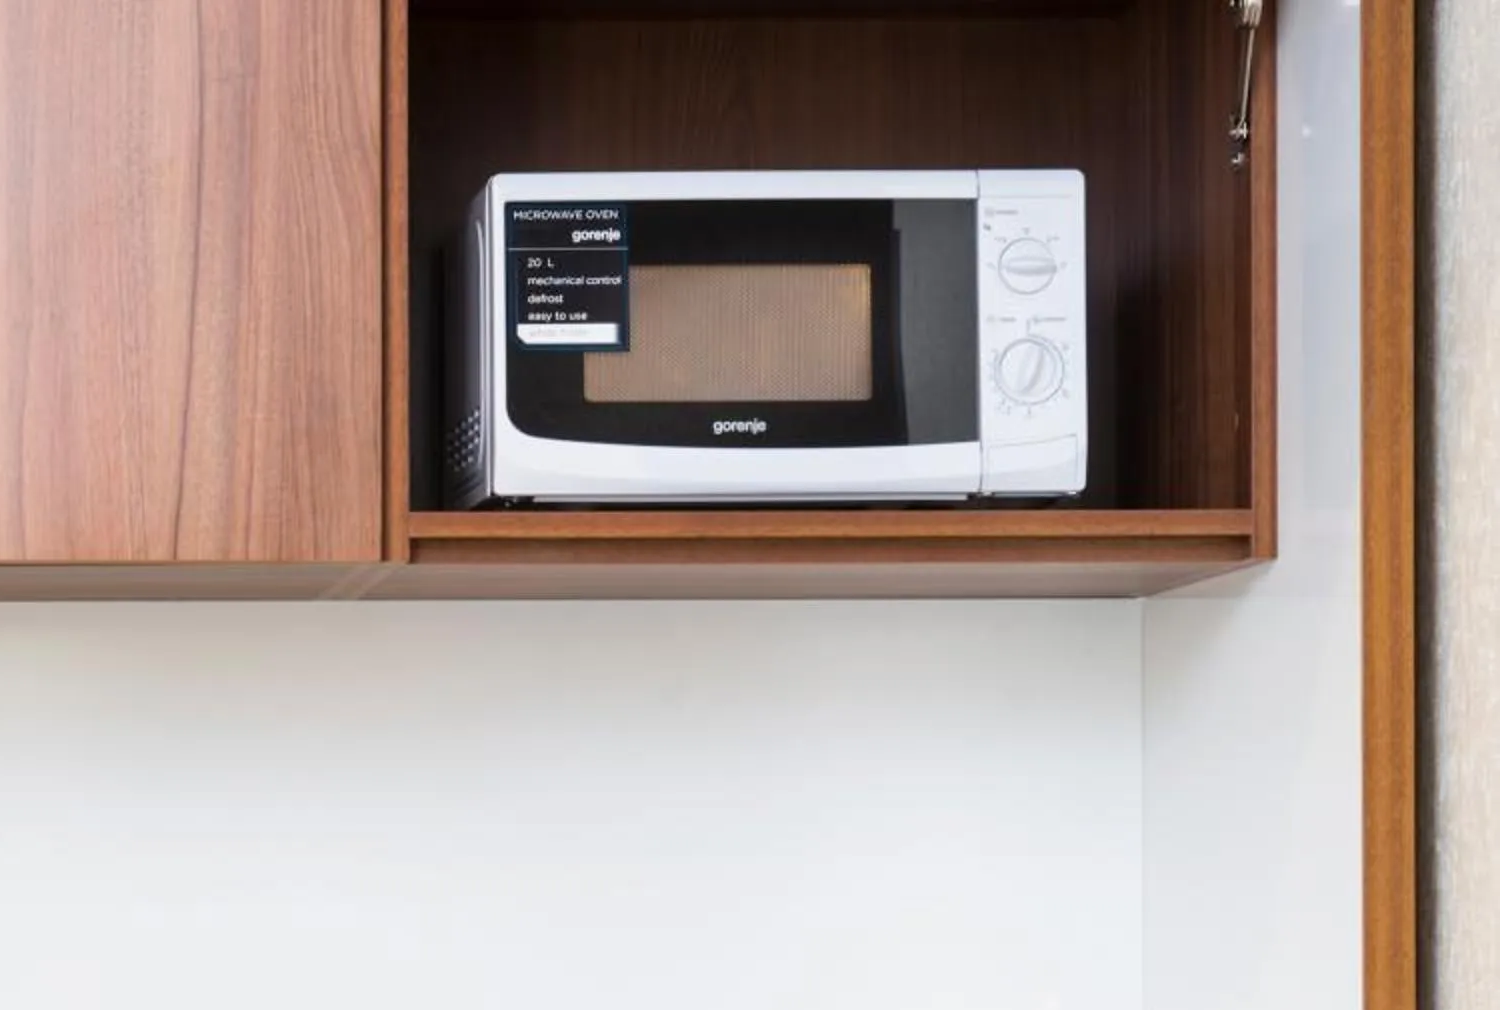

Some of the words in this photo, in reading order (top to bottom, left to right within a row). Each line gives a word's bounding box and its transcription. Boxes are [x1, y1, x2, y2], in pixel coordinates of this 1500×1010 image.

[513, 209, 583, 221] MICROWAVE
[585, 209, 619, 220] OVEN
[571, 228, 621, 243] gorenje
[527, 258, 542, 268] 20
[527, 275, 584, 286] mechanical
[586, 275, 621, 285] control
[527, 294, 564, 304] defrost
[527, 312, 552, 323] easy
[555, 311, 567, 321] to
[569, 313, 588, 321] use
[713, 417, 767, 435] gorenje
